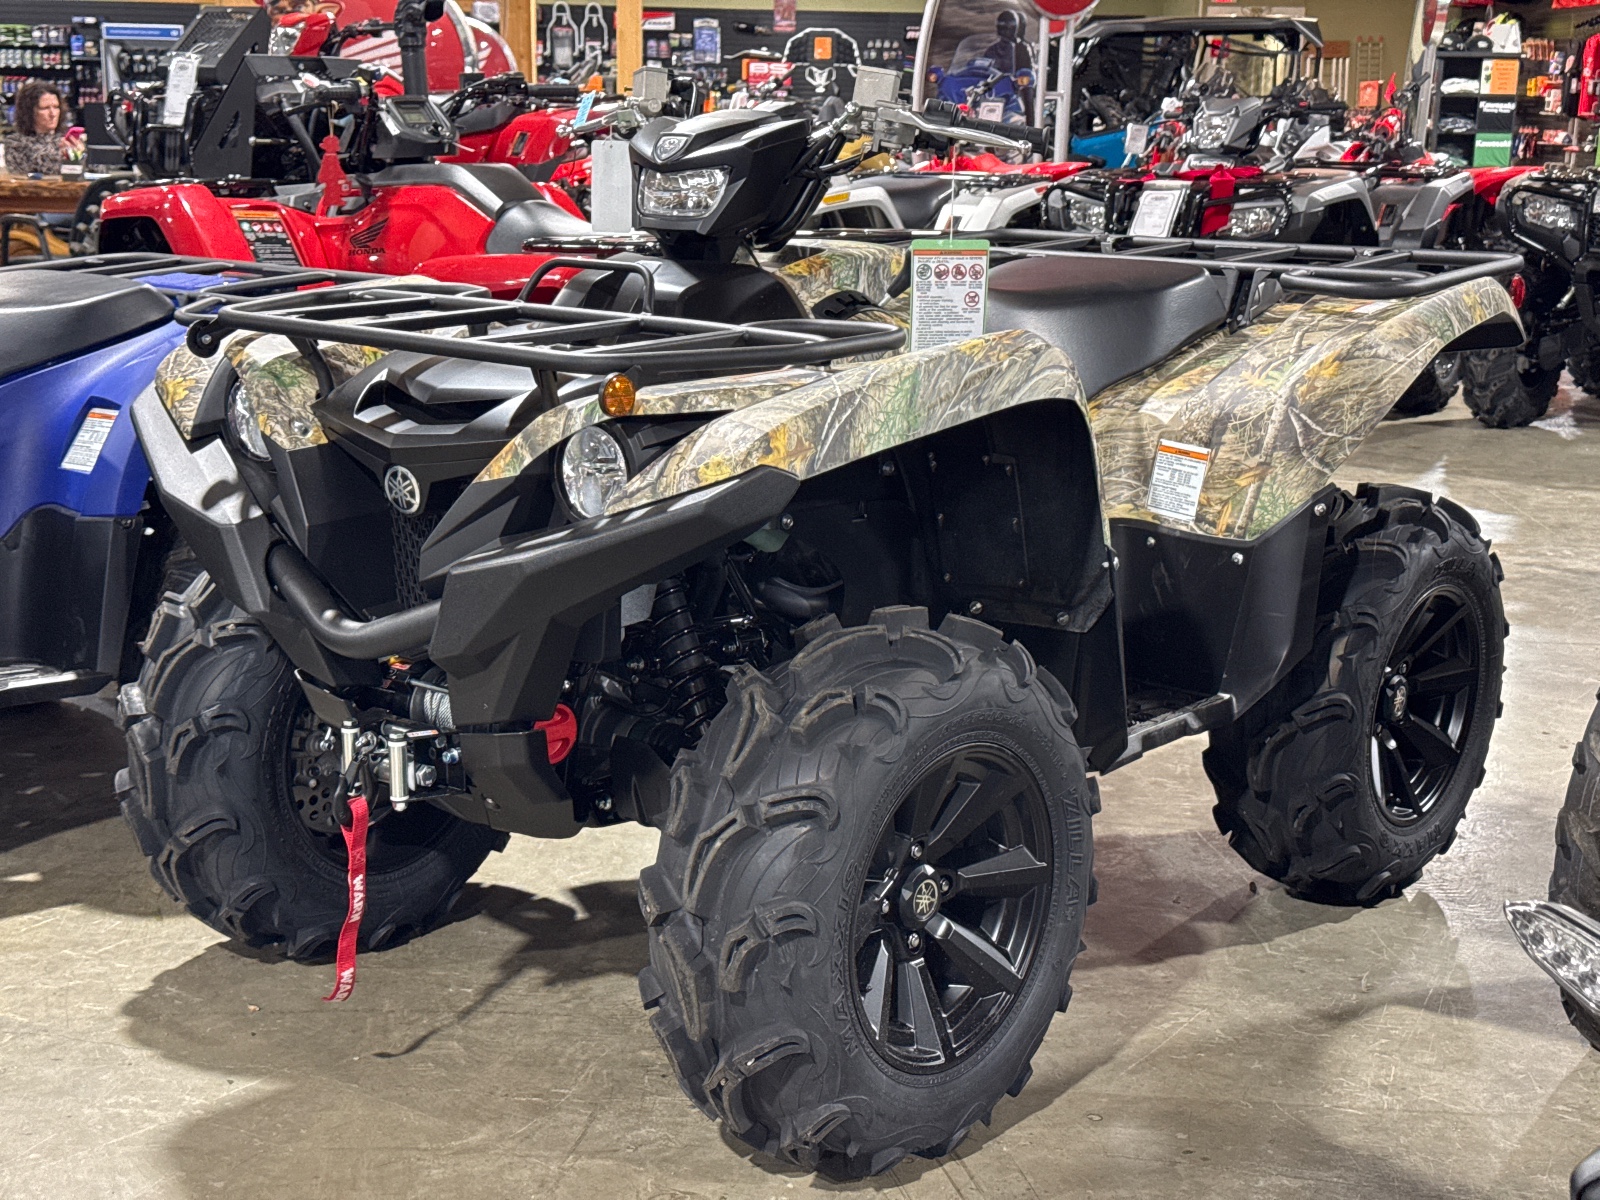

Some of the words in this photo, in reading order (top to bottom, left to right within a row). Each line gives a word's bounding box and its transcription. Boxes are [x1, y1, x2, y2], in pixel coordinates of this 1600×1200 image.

[749, 63, 788, 75] BS
[348, 247, 386, 256] HONDA
[1062, 795, 1084, 906] ZILLA
[349, 874, 364, 923] WARN
[831, 859, 861, 1057] MAXXIS
